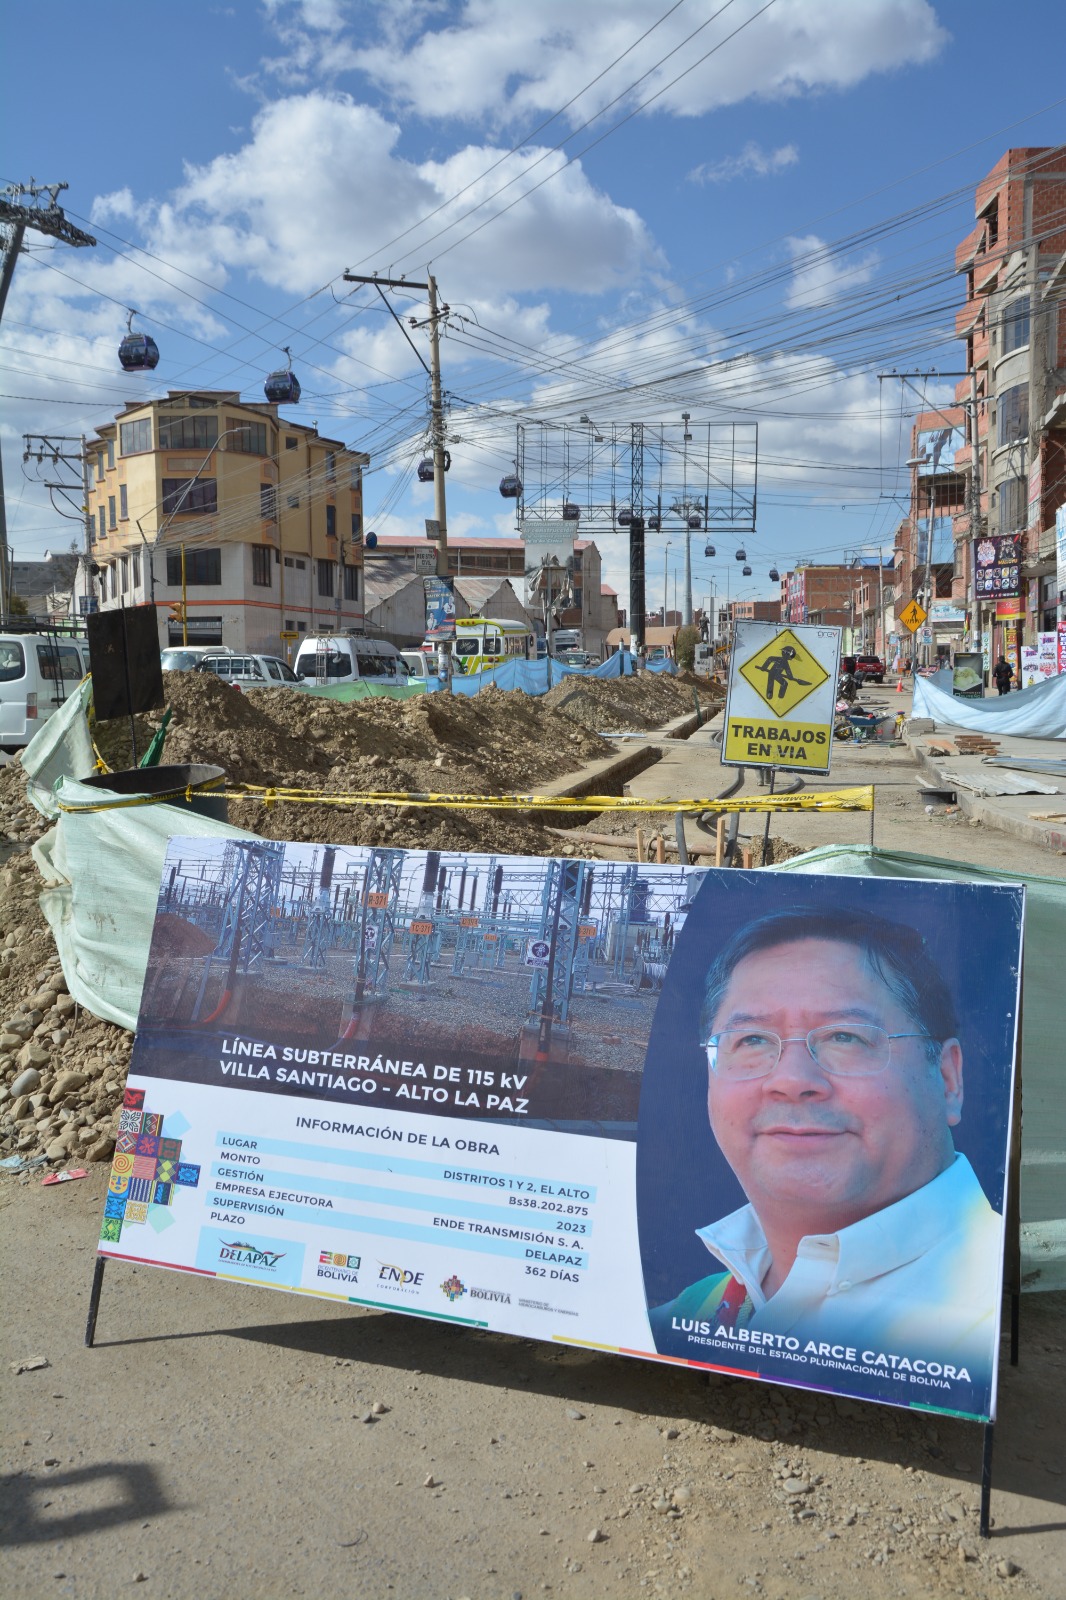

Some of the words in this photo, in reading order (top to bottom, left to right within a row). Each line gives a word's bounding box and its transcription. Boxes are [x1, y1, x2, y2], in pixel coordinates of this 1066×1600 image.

[732, 724, 826, 744] TRABAJOS
[747, 742, 772, 756] EN
[777, 744, 807, 760] VIA
[221, 1036, 277, 1060] LÍNEA
[282, 1047, 427, 1078] SUBTERRÁNEA
[433, 1065, 462, 1082] DE
[467, 1069, 495, 1086] 115
[500, 1072, 528, 1090] kV
[220, 1060, 270, 1080] VILLA
[276, 1068, 377, 1094] SANTIAGO
[395, 1084, 448, 1103] ALTO
[454, 1090, 480, 1108] LA
[486, 1094, 530, 1114] PAZ
[222, 1136, 258, 1150] LUGAR
[296, 1116, 403, 1142] INFORMACIÓN
[407, 1132, 428, 1146] DE
[432, 1136, 450, 1149] LA
[455, 1139, 500, 1156] OBRA
[220, 1151, 260, 1165] MONTO
[218, 1167, 264, 1182] GESTIÓN
[215, 1181, 266, 1198] EMPRESA
[268, 1190, 334, 1208] EJECUTORA
[443, 1170, 506, 1188] DISTRITOS
[508, 1180, 513, 1188] 1
[516, 1180, 524, 1190] Y
[526, 1182, 537, 1193] 2,
[540, 1184, 554, 1195] EL
[557, 1187, 590, 1200] ALTO
[213, 1197, 284, 1216] SUPERVISIÓN
[508, 1196, 589, 1216] Bs38.202.875
[210, 1212, 246, 1225] PLAZO
[556, 1221, 586, 1234] 2023
[433, 1217, 465, 1230] ENDE
[468, 1223, 554, 1245] TRANSMISIÓN
[558, 1238, 568, 1248] S.
[571, 1240, 584, 1250] A.
[220, 1247, 278, 1268] DELAPAZ
[525, 1248, 582, 1267] DELAPAZ
[317, 1269, 358, 1284] BOLIVIA
[378, 1266, 425, 1286] ENDE
[524, 1266, 546, 1278] 362
[550, 1269, 580, 1283] DÍAS
[470, 1289, 511, 1304] BOLIVIA
[671, 1316, 710, 1336] LUIS
[714, 1325, 800, 1350] ALBERTO
[804, 1340, 857, 1362] ARCE
[861, 1350, 972, 1383] CATACORA
[688, 1334, 746, 1352] PRESIDENTE
[748, 1346, 767, 1356] DEL
[769, 1349, 808, 1363] ESTADO
[810, 1357, 890, 1378] PLURINACIONAL
[893, 1372, 907, 1382] DE
[910, 1375, 951, 1390] BOLIVIA
